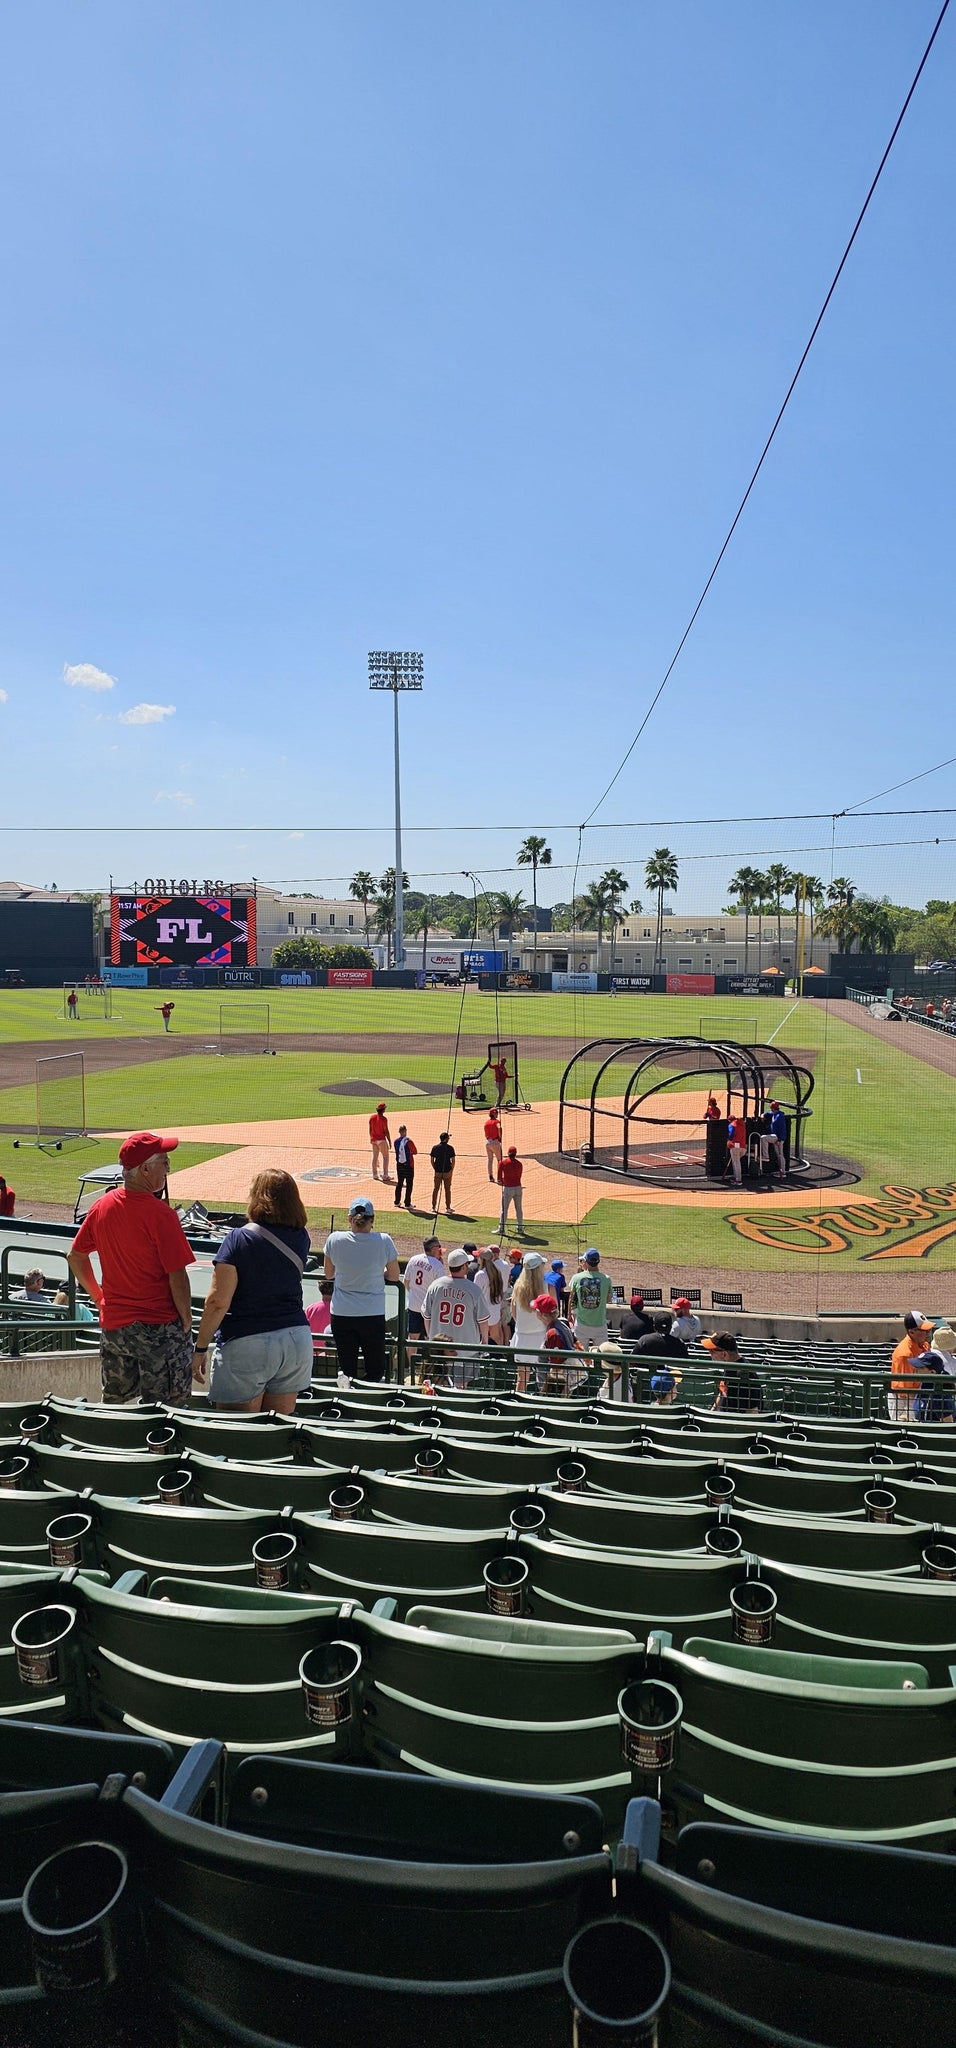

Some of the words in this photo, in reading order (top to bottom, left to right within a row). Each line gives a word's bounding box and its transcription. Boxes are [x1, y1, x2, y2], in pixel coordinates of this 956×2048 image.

[144, 878, 225, 896] ORIOLES
[156, 918, 213, 944] FL
[224, 970, 254, 981] NÜTRL
[280, 971, 312, 985] smh
[415, 1270, 423, 1286] 3
[443, 1287, 466, 1300] UTLEY
[439, 1301, 466, 1327] 26
